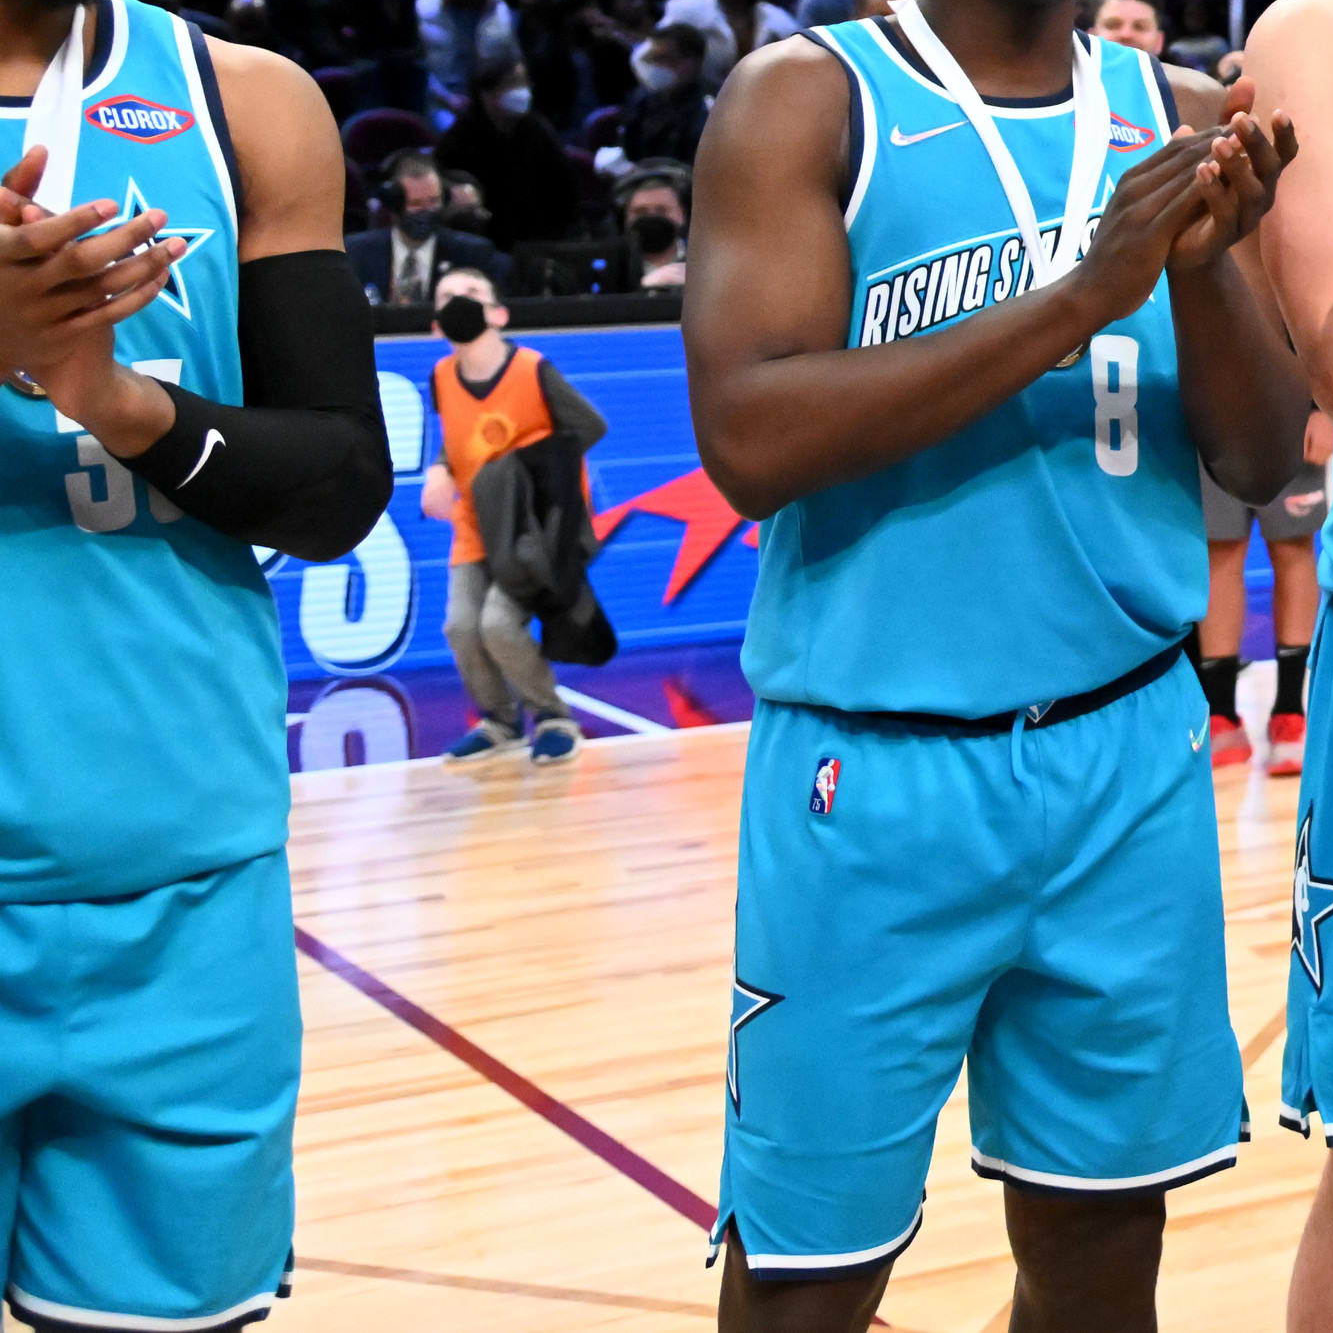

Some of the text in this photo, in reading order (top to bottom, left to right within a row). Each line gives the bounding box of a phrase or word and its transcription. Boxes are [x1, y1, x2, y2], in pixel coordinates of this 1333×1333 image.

[99, 104, 182, 133] CLOROX
[1109, 124, 1146, 144] ROX
[861, 245, 993, 348] RISING
[1090, 335, 1139, 477] 8
